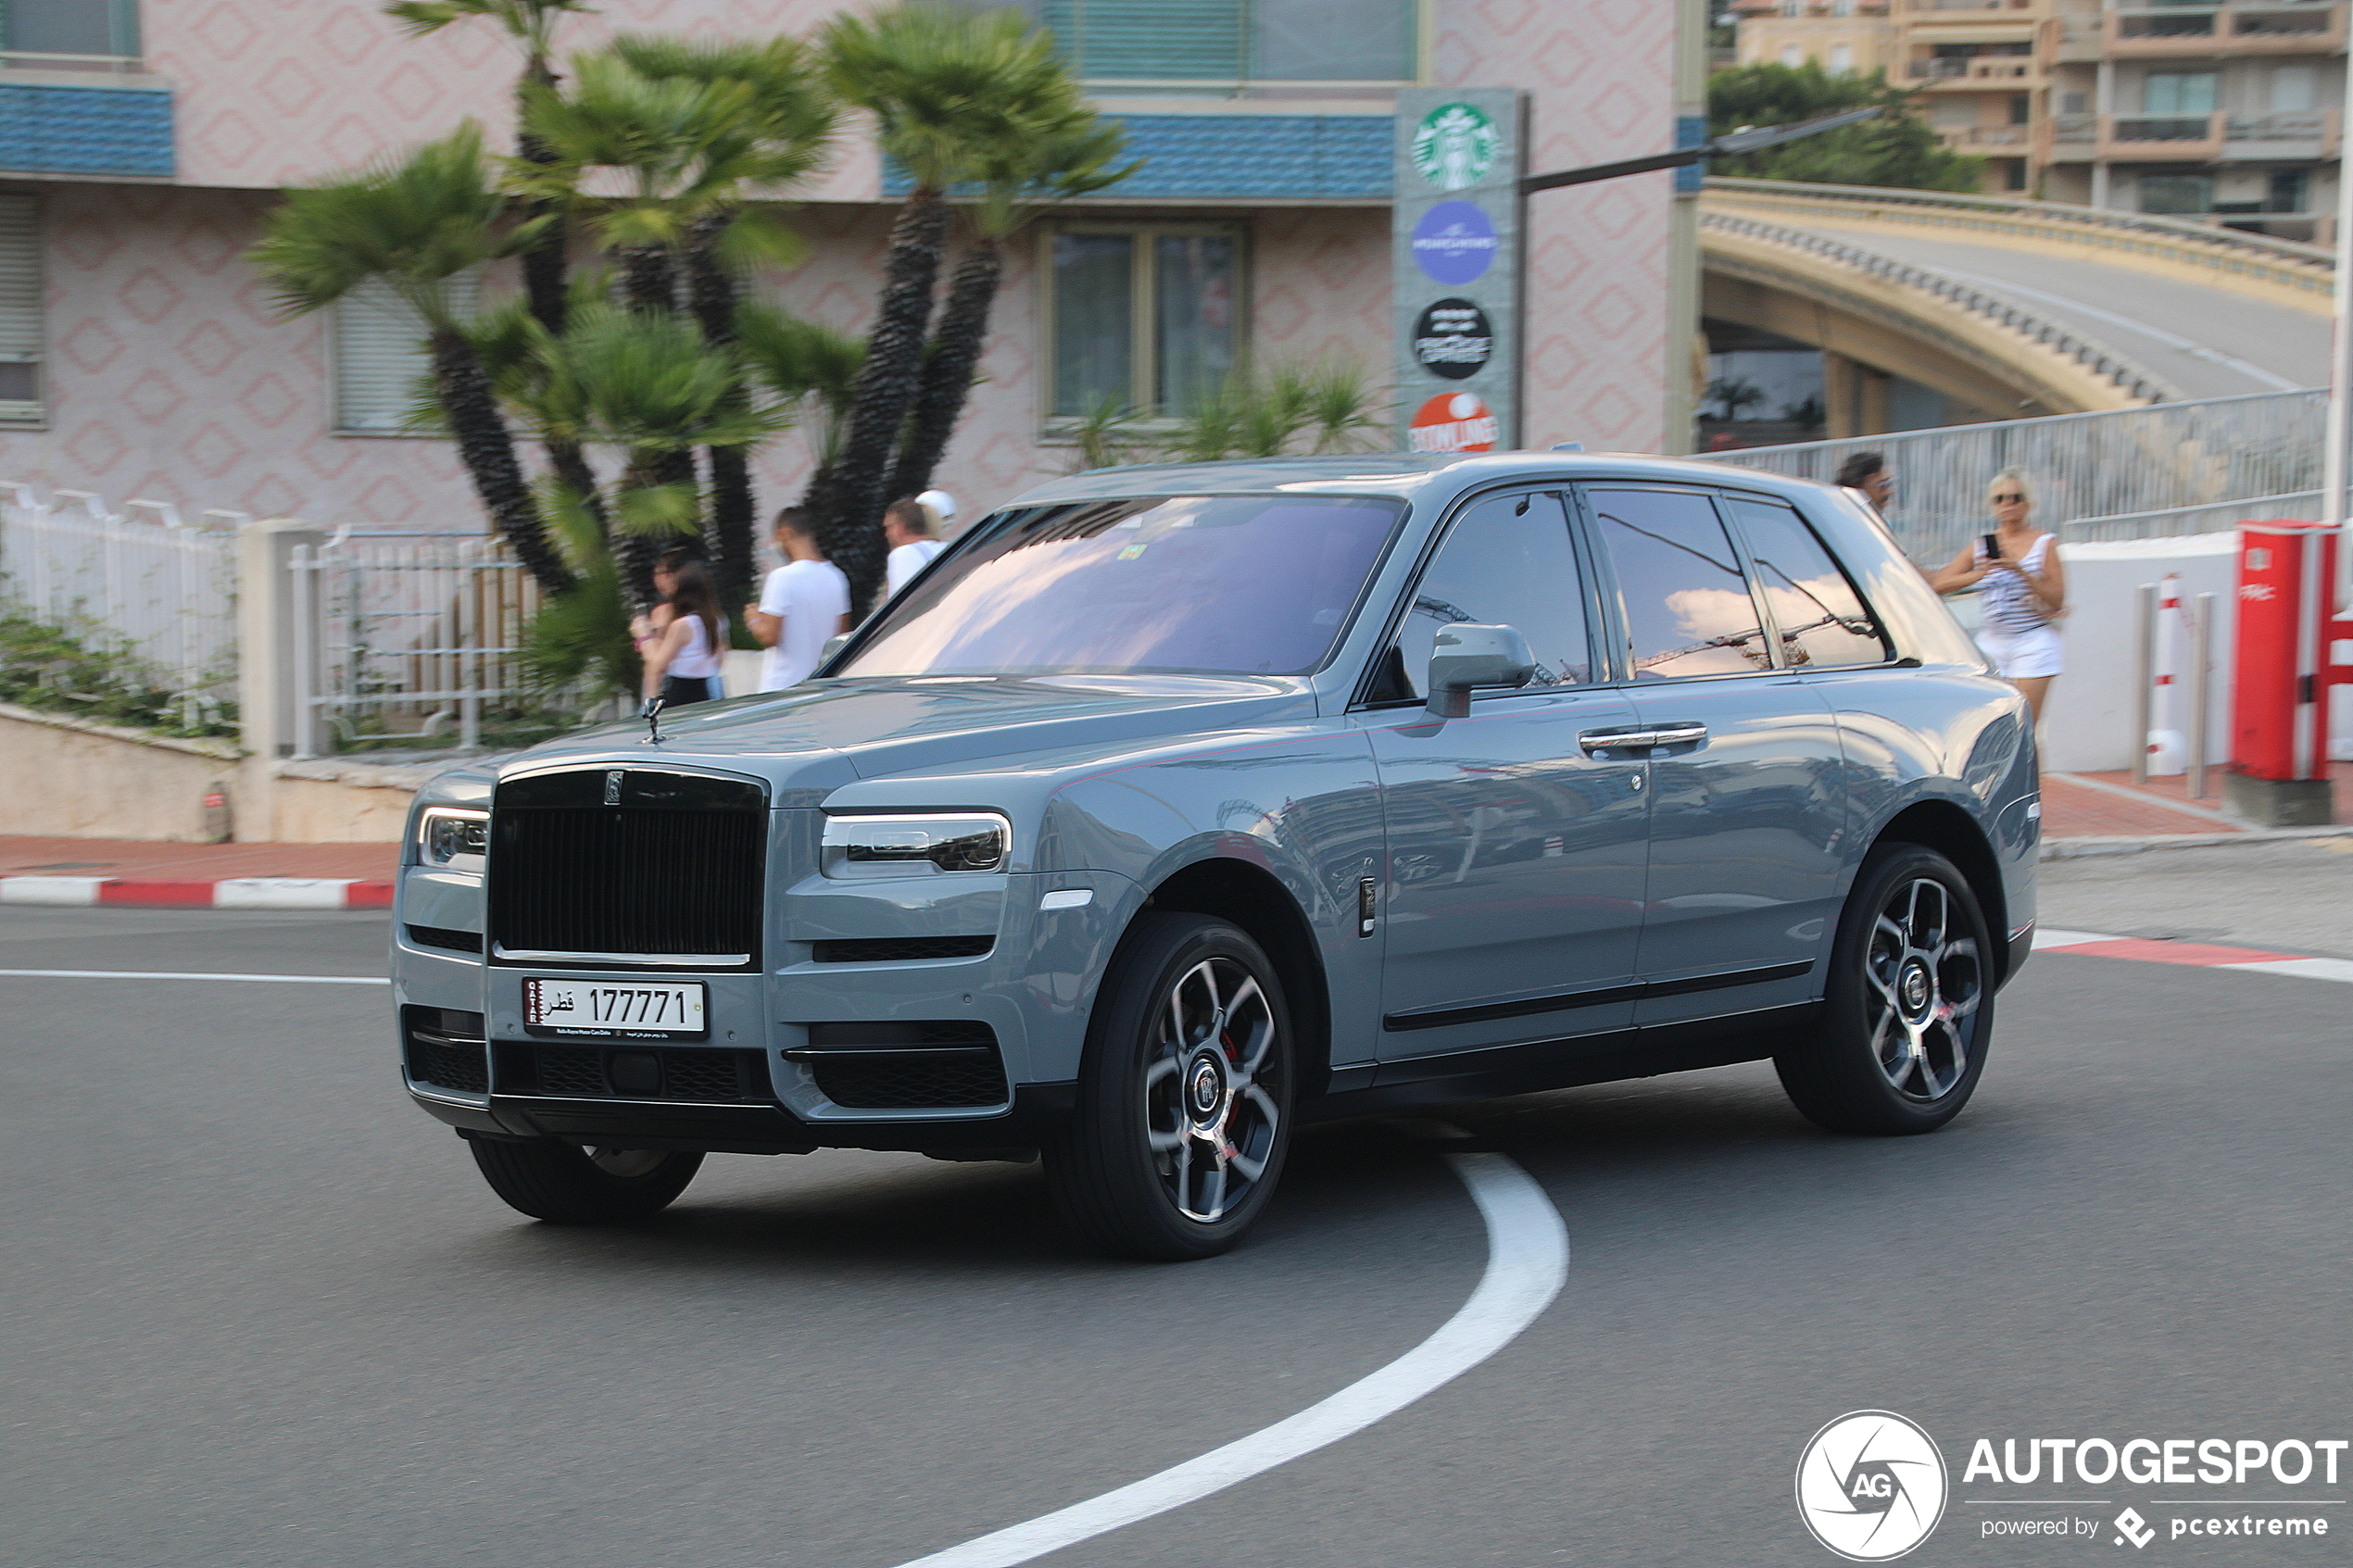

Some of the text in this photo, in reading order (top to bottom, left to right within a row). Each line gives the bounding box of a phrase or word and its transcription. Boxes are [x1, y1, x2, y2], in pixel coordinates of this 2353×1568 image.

[528, 981, 537, 1022] QATAR
[543, 990, 573, 1016] قطر
[590, 988, 686, 1023] 177771
